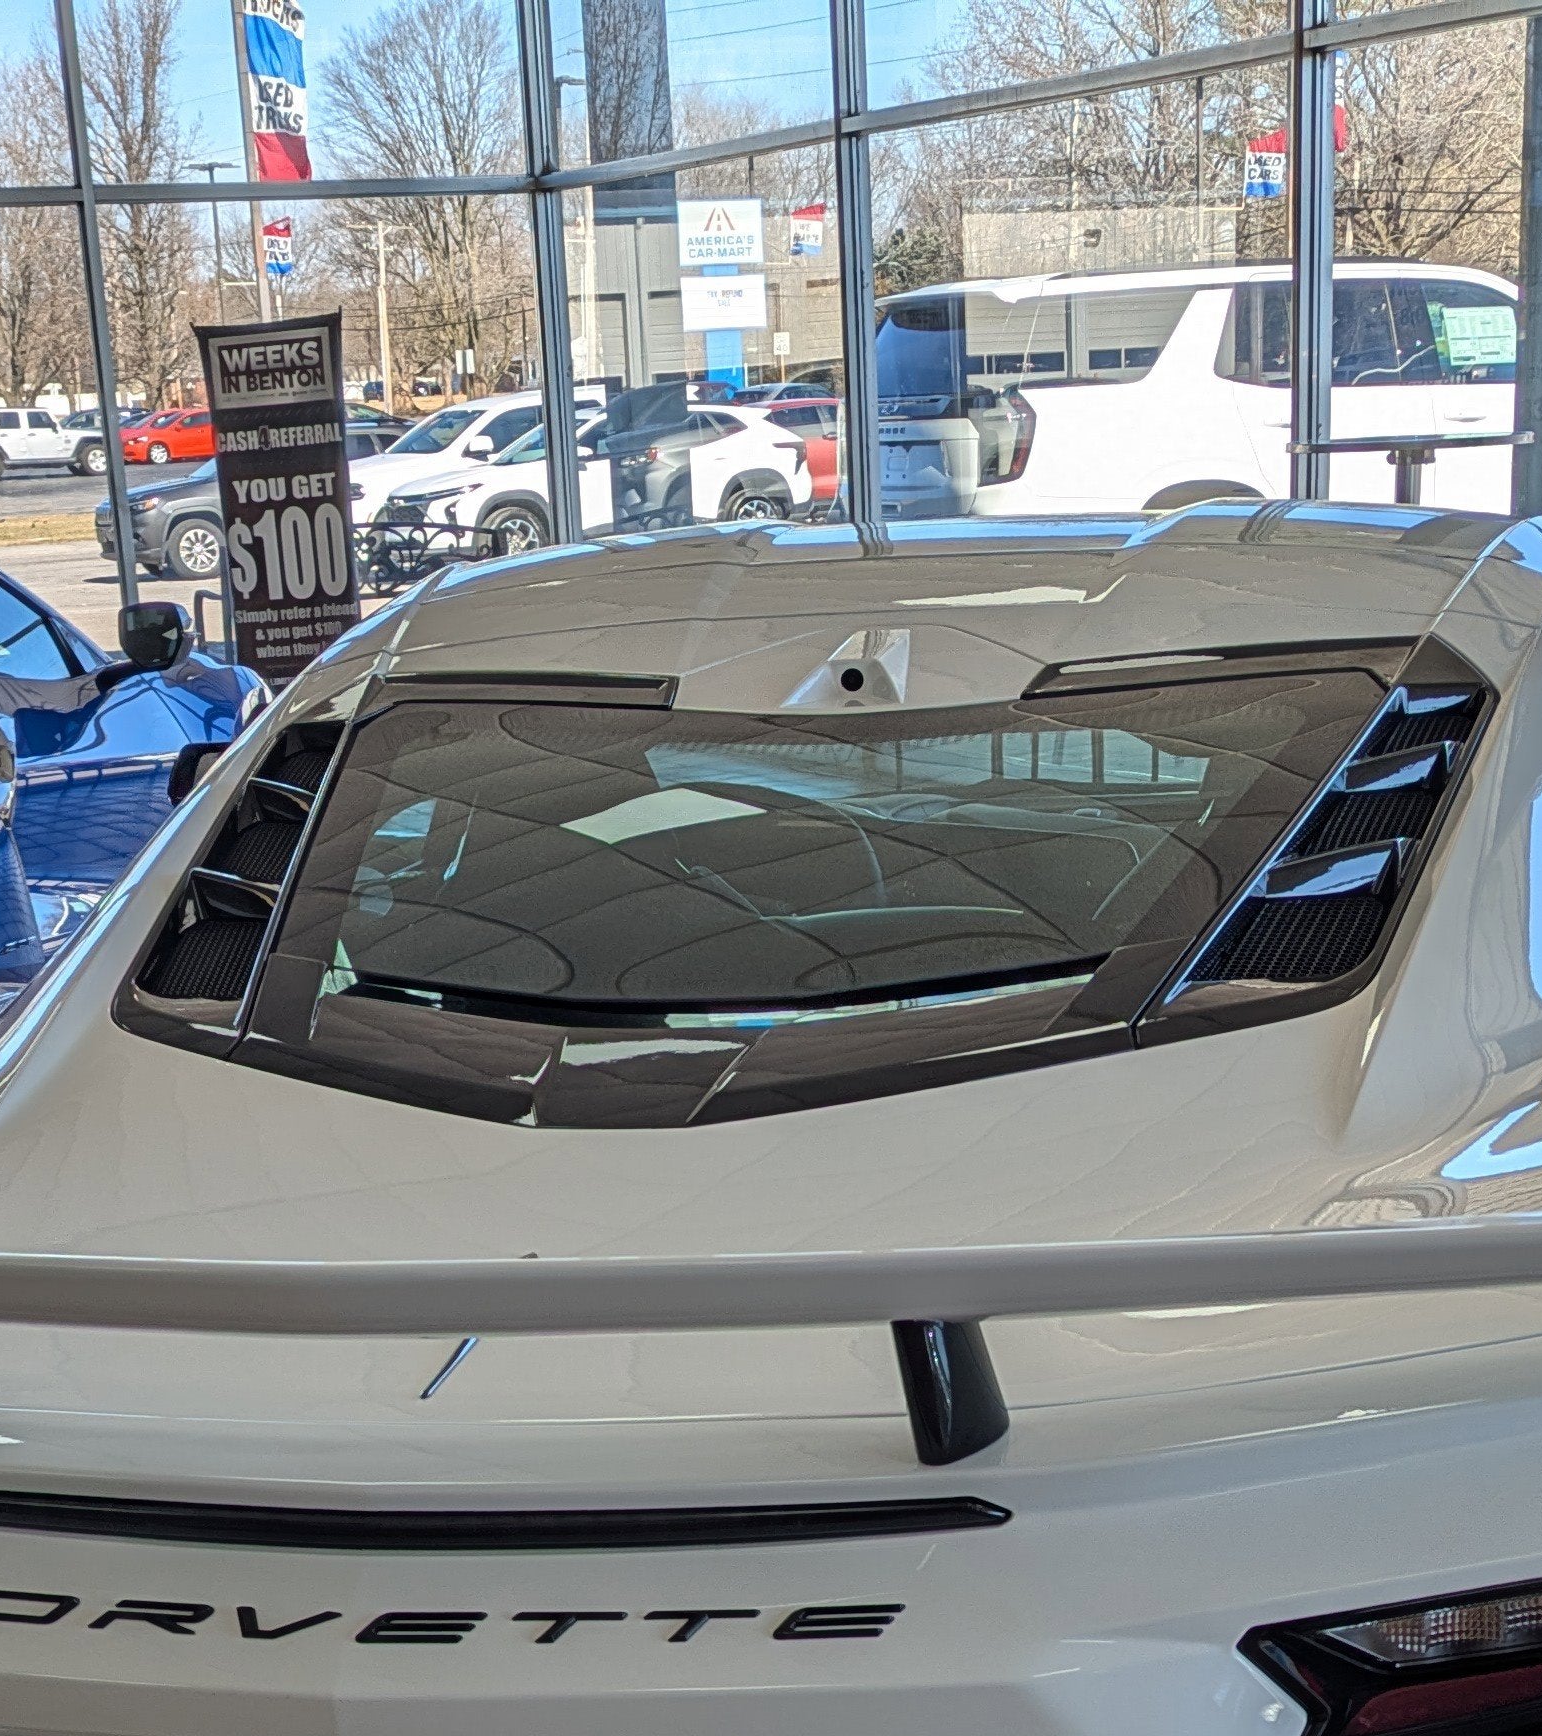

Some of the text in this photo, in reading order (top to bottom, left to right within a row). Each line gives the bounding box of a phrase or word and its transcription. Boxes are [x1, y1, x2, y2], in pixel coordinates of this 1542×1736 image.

[1247, 167, 1280, 181] CARS
[686, 234, 755, 247] AMERICA'S
[688, 246, 753, 259] CAR-MART
[221, 340, 321, 373] WEEKS
[221, 367, 326, 394] IN BENTON
[232, 472, 336, 504] YOU GET
[227, 503, 349, 601] $100
[235, 607, 279, 624] Simply
[280, 605, 312, 621] refer
[255, 628, 266, 641] &
[266, 626, 291, 641] you
[291, 623, 314, 640] get
[255, 644, 291, 659] when
